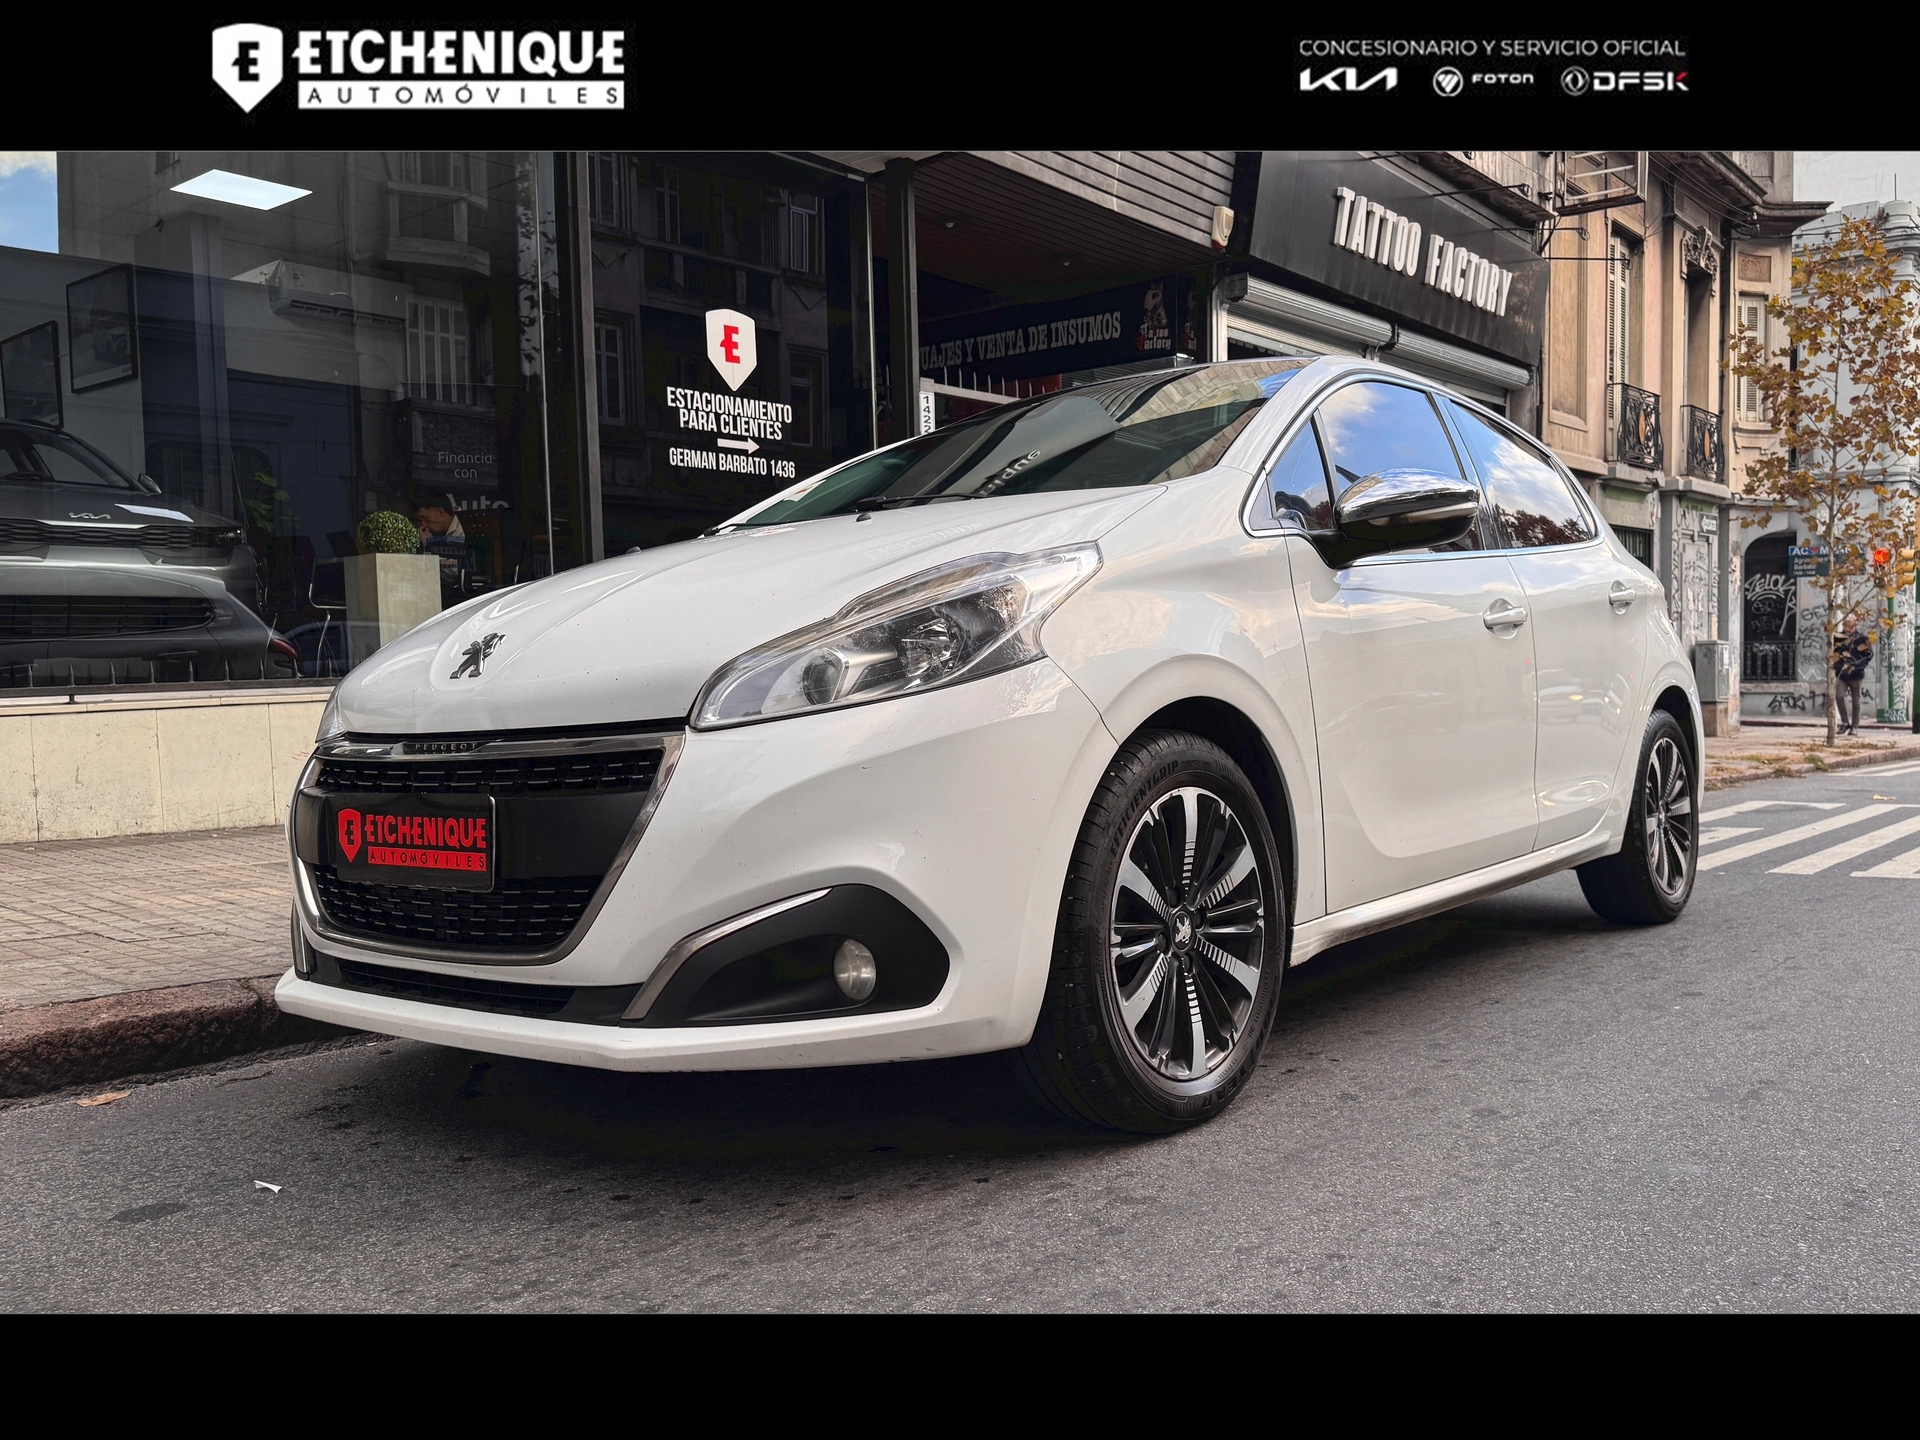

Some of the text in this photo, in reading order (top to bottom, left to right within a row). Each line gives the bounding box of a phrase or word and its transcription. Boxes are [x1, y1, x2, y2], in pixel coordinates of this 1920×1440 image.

[1334, 186, 1512, 317] TATTOO FACTORY
[964, 342, 974, 362] Y
[974, 325, 1026, 361] VENTA
[1027, 325, 1048, 352] DE
[1050, 311, 1122, 348] INSUMOS
[666, 386, 793, 424] ESTACIONAMIENTO
[679, 408, 783, 441] PARA CLIENTES
[438, 452, 493, 464] Financia
[454, 468, 478, 478] con
[669, 447, 796, 479] GERMAN BARBATO 1436
[1111, 759, 1179, 859] EFFICIENTGRIP
[364, 814, 487, 849] ETCHENIQUE
[370, 851, 485, 868] AUTOMÓVILES
